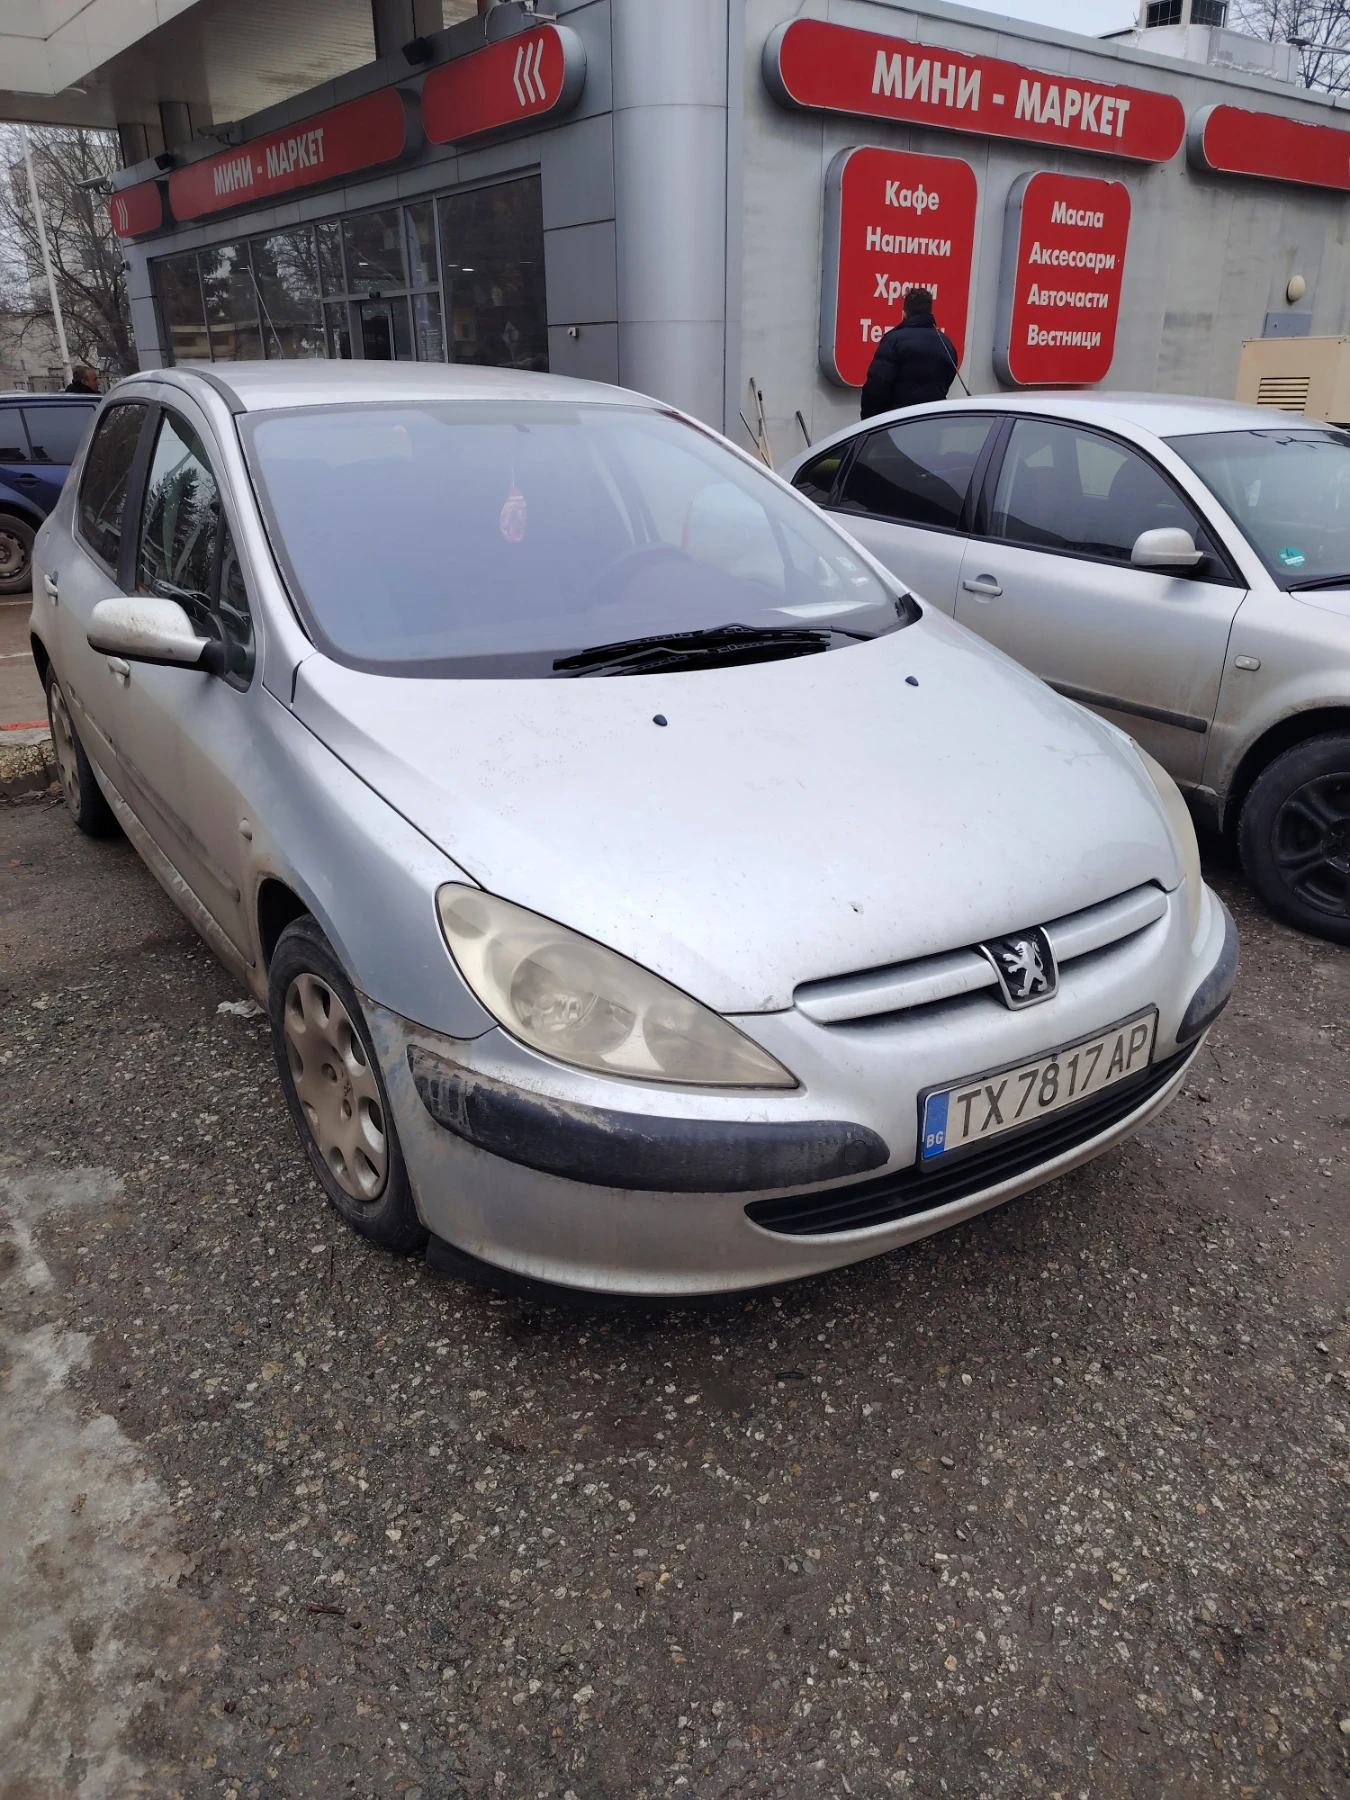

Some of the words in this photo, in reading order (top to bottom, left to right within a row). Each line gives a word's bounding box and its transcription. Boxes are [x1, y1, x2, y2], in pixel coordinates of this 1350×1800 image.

[871, 50, 981, 111] МИНИ
[1014, 79, 1130, 137] МАРКЕТ
[213, 155, 254, 196] МИНИ
[265, 128, 324, 179] МАРКЕТ
[884, 179, 940, 216] Кафе
[1051, 201, 1105, 228] Масла
[866, 226, 951, 256] Напитки
[1028, 241, 1116, 275] Аксесоари
[1026, 283, 1109, 309] Авточасти
[1027, 324, 1102, 350] Вестници
[957, 1079, 1009, 1138] TX
[1013, 1042, 1104, 1118] 7817
[1105, 1023, 1148, 1080] AP
[926, 1130, 945, 1148] BG
